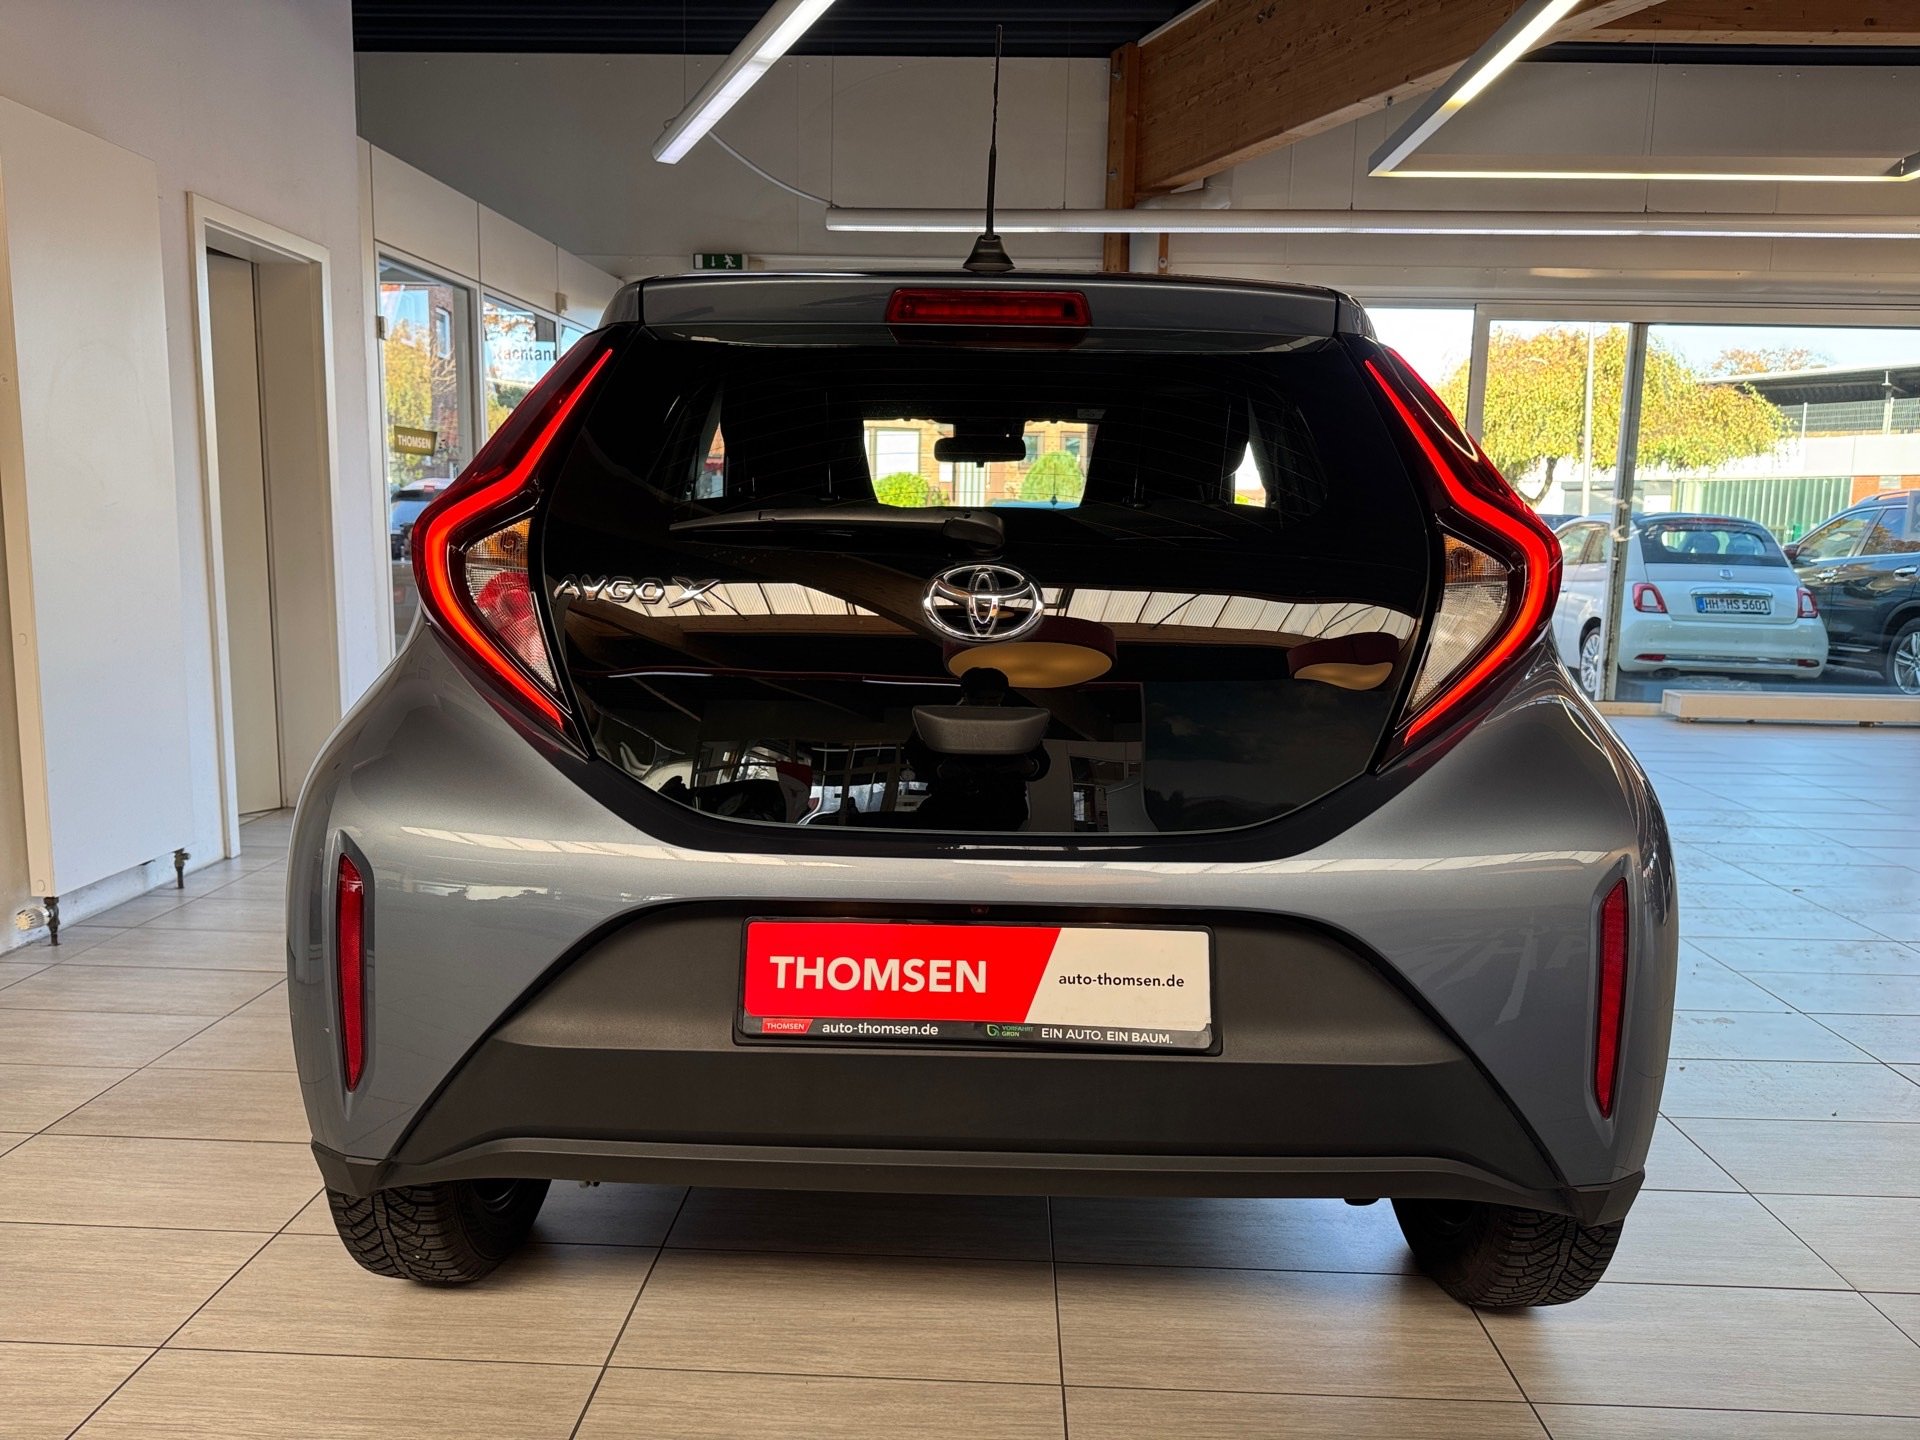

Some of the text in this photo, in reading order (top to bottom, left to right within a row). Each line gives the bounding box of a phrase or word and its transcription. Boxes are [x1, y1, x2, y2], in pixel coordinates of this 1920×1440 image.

[397, 434, 432, 449] THOMSEN
[668, 576, 720, 612] X
[1705, 598, 1769, 611] HH HS 5601
[769, 955, 987, 994] THOMSEN
[1058, 973, 1185, 988] auto-thomsen.de
[766, 1022, 805, 1031] THOMSEN
[822, 1022, 939, 1036] auto-thomsen.de
[1041, 1027, 1173, 1044] EIN AUTO. EIN BAUM.
